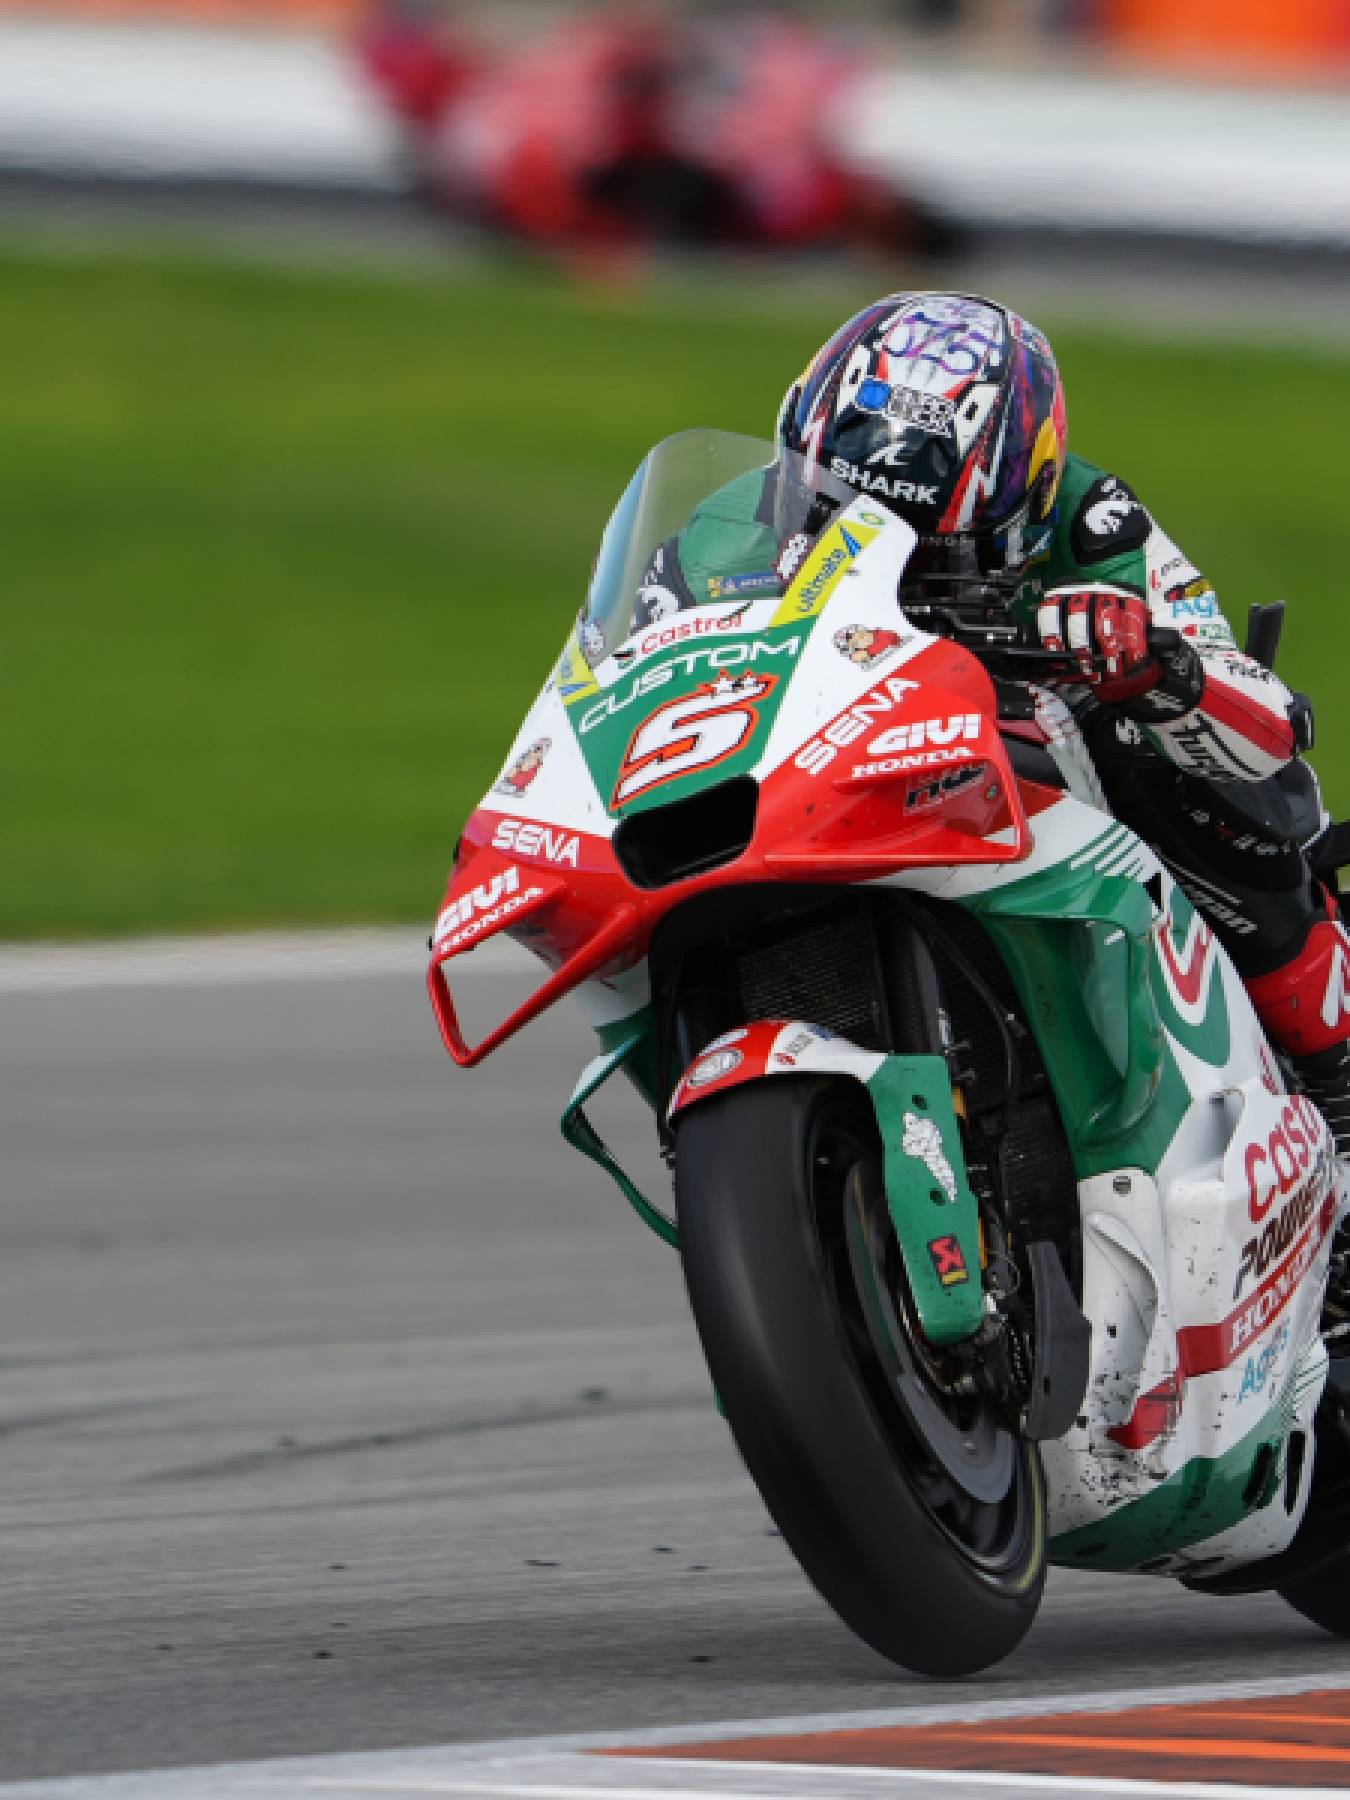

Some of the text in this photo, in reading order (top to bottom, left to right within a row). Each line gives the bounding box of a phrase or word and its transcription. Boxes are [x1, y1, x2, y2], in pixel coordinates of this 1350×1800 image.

[830, 456, 939, 505] SHARK
[796, 548, 847, 614] ultimate
[641, 612, 745, 654] Castrol
[579, 635, 800, 735] CUSTOM
[795, 676, 921, 776] SENA
[867, 713, 981, 756] GIVI
[851, 745, 976, 778] HONDA
[491, 818, 580, 867] SENA
[435, 866, 520, 945] GIVI
[440, 886, 545, 953] HONDA
[1244, 1095, 1321, 1223] Cast
